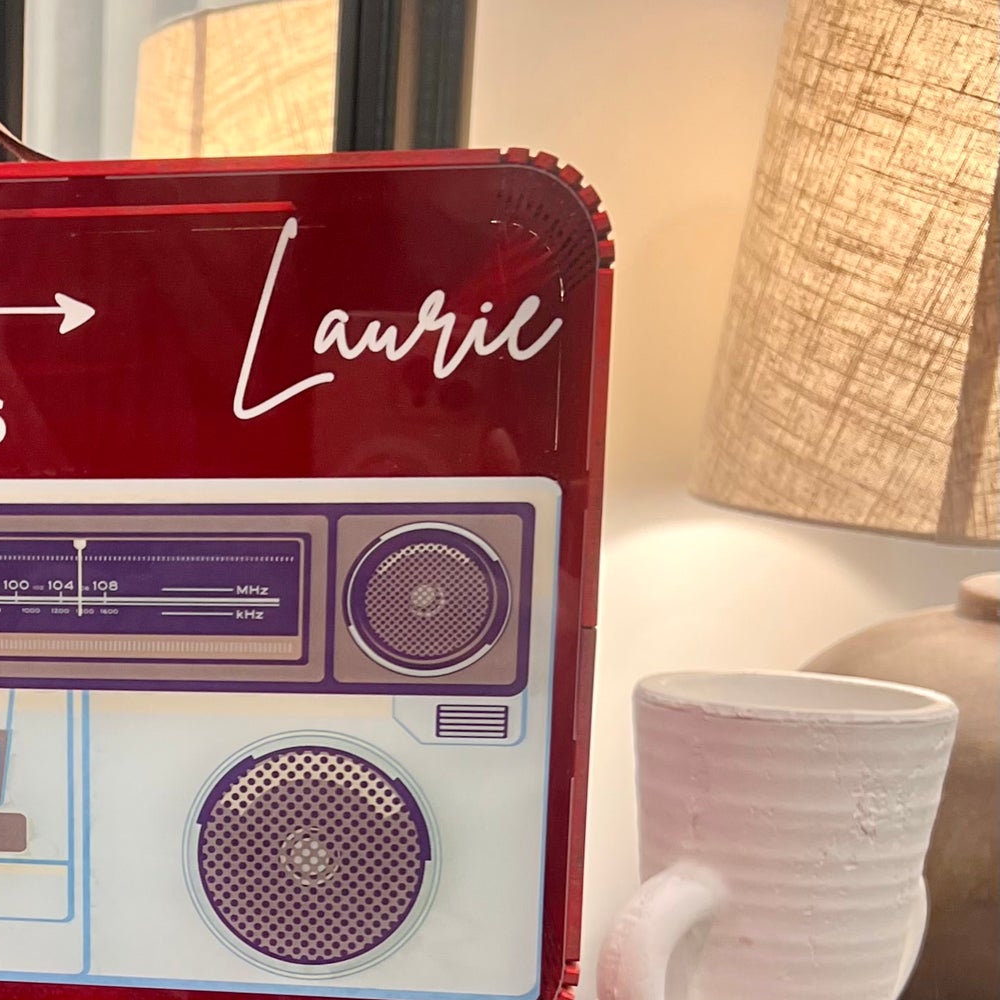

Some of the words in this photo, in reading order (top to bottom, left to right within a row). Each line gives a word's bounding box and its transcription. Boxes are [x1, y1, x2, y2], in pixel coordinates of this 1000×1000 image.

[233, 217, 563, 419] Laurie
[3, 580, 29, 590] 100
[48, 580, 74, 590] 104
[92, 580, 118, 591] 108
[236, 585, 269, 596] MHz
[236, 610, 264, 620] kHz
